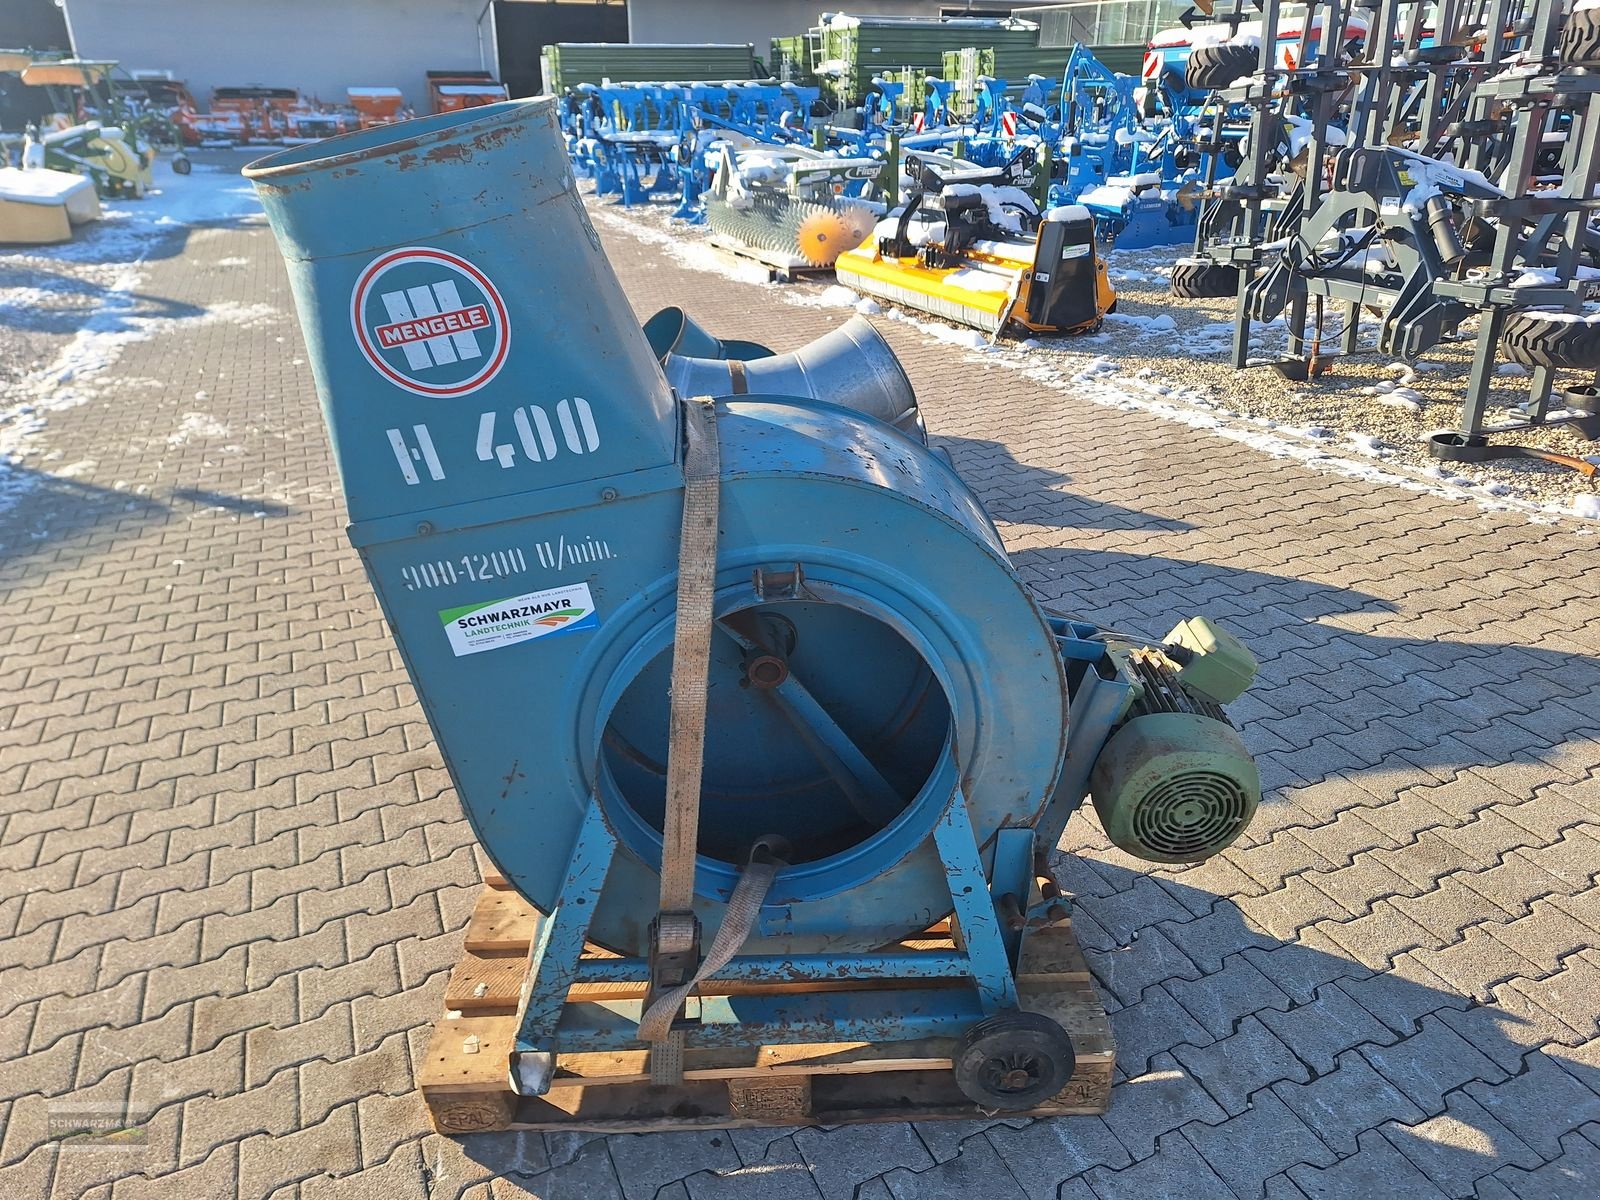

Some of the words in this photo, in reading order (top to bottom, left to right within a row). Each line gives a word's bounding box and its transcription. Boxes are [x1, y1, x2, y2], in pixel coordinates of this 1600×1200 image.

[856, 165, 882, 178] Fliegl
[383, 309, 484, 344] MENGELE
[386, 423, 446, 486] H
[475, 397, 600, 468] 400
[401, 547, 527, 592] 900-1200
[535, 535, 618, 571] U/min.
[457, 598, 572, 629] SCHWARZMAYR
[464, 619, 531, 638] LANDTECHNIK
[447, 1111, 490, 1127] EPAL
